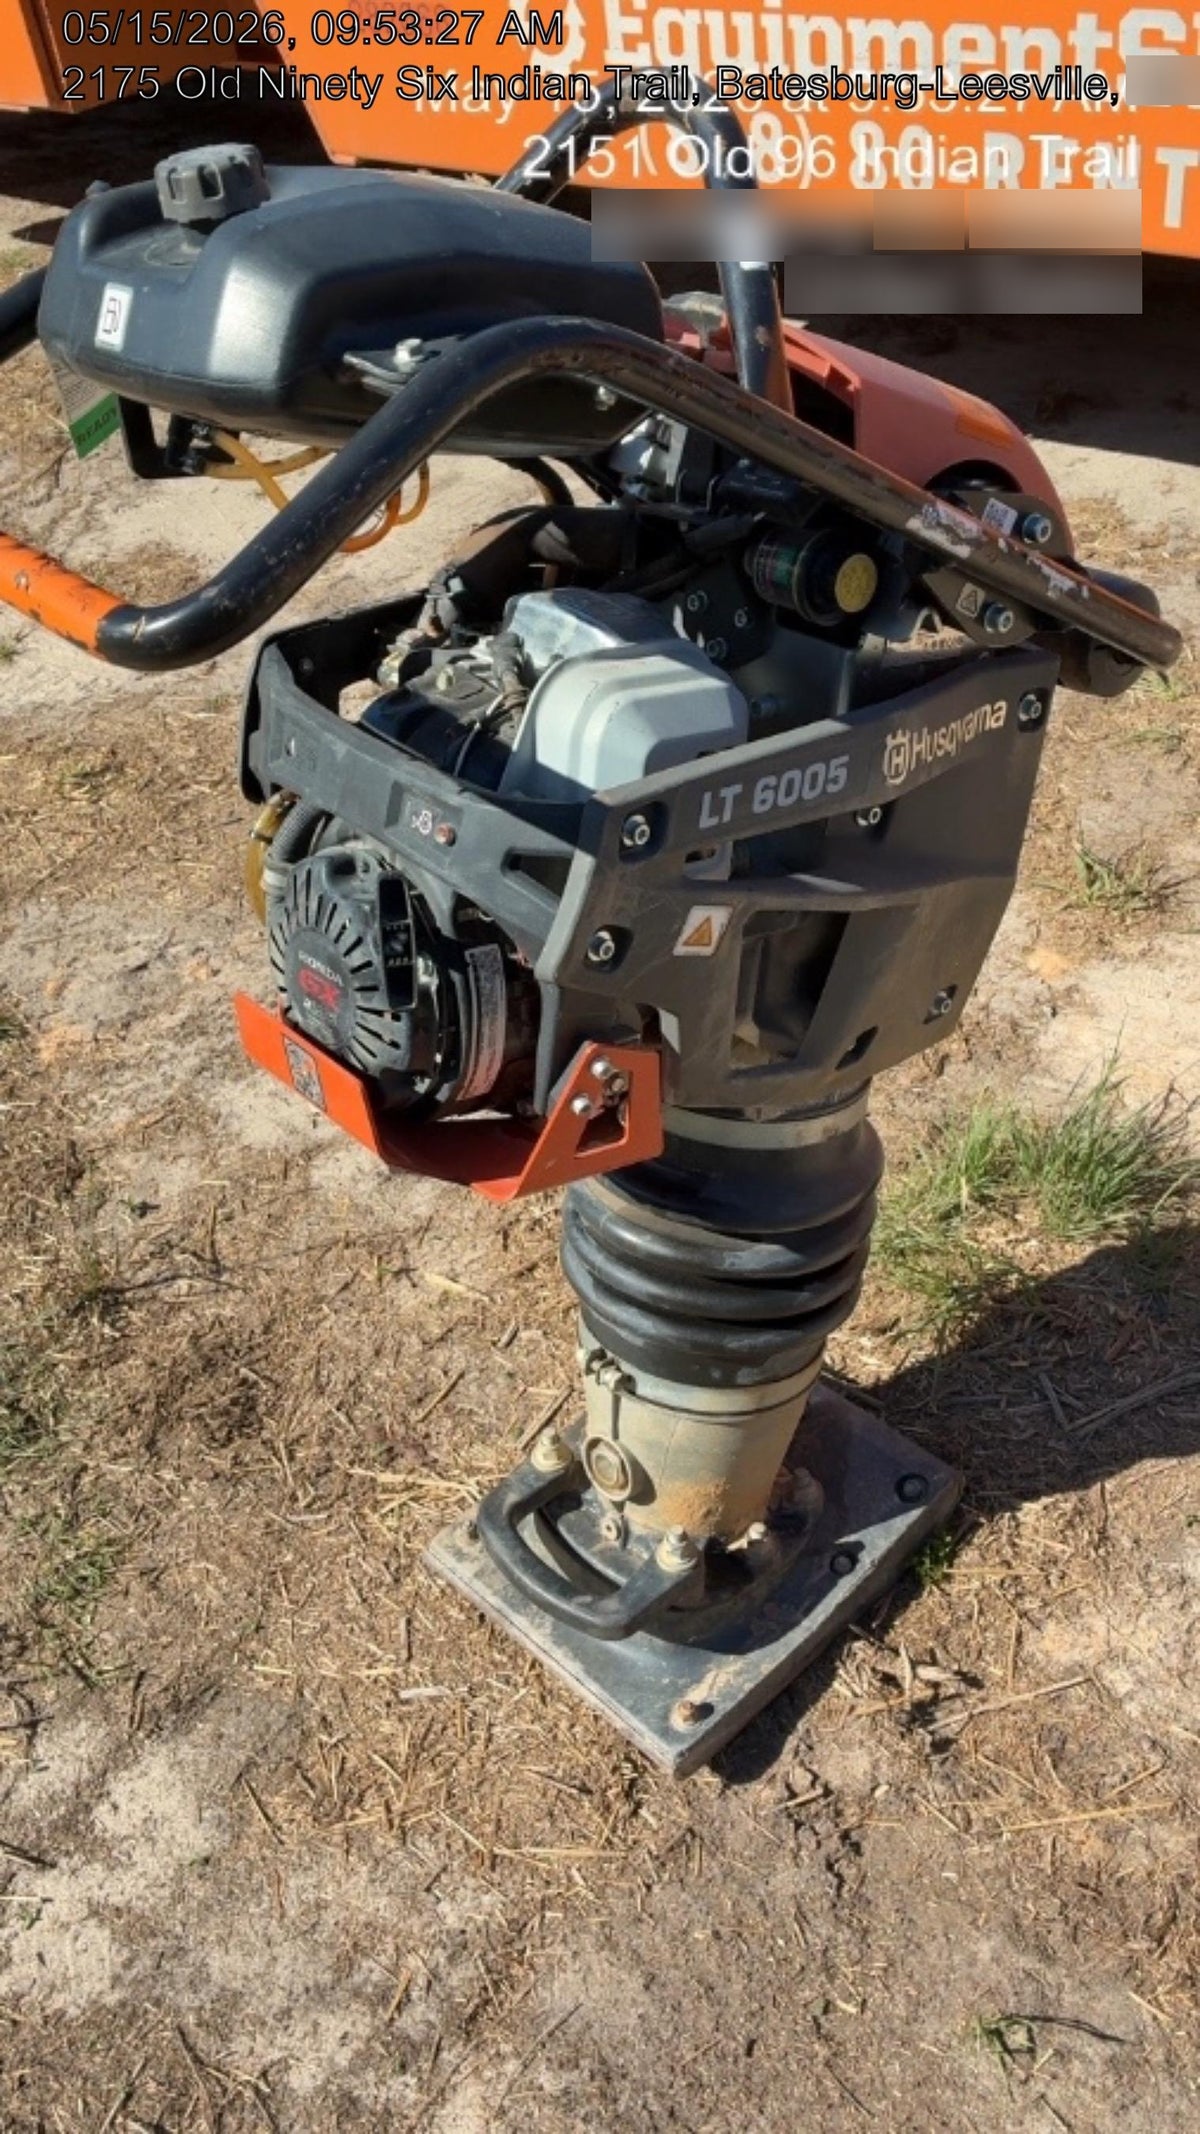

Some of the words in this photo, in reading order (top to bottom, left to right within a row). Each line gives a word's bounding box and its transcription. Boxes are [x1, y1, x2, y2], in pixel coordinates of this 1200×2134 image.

[603, 0, 1200, 97] EquipmentS
[910, 700, 1008, 772] Husqvarna
[698, 783, 743, 829] LT
[752, 756, 851, 814] 6005
